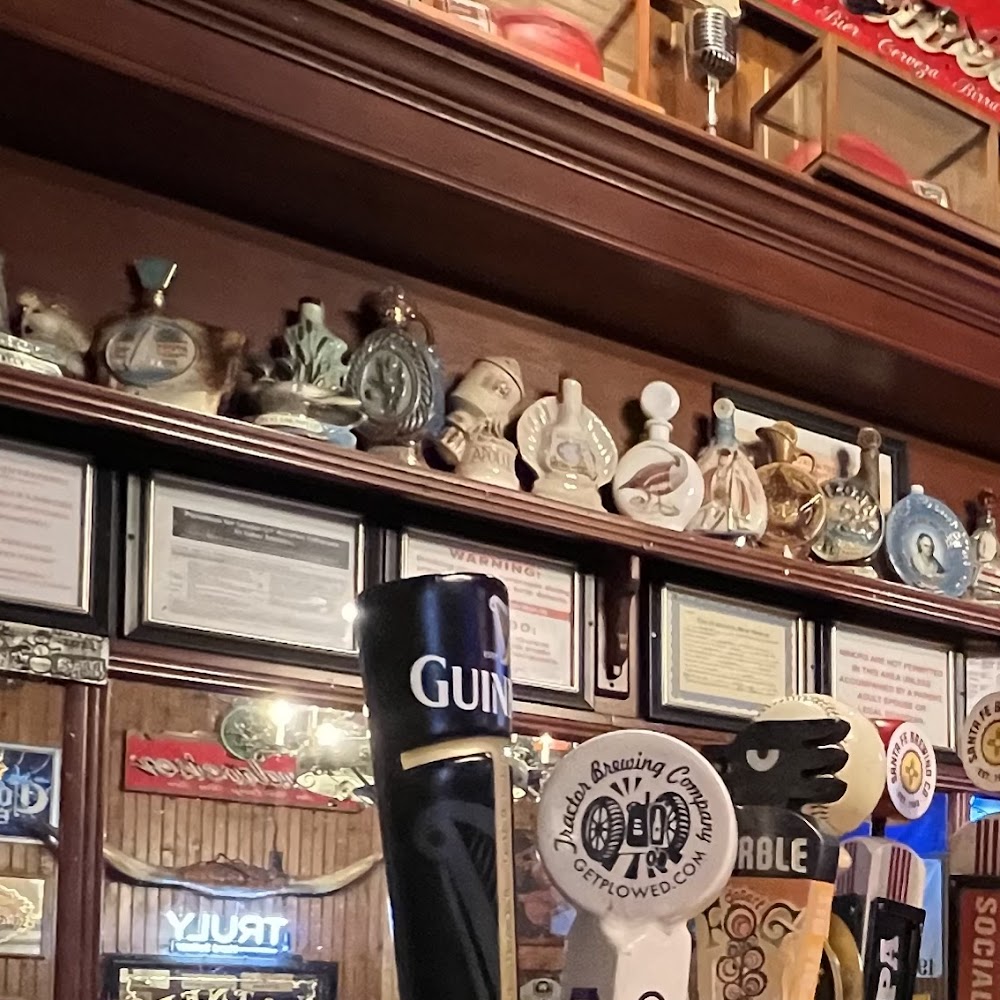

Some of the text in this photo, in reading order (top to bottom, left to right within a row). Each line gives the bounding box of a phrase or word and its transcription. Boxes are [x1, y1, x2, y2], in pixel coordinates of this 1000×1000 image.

[877, 38, 939, 80] Cerveza
[410, 654, 512, 718] GUIN
[967, 720, 981, 764] SANTA
[979, 705, 992, 722] FE
[554, 751, 713, 854] Tractor Brewing Company
[573, 851, 707, 898] GETPLOWED.COM
[738, 835, 808, 874] RBLE
